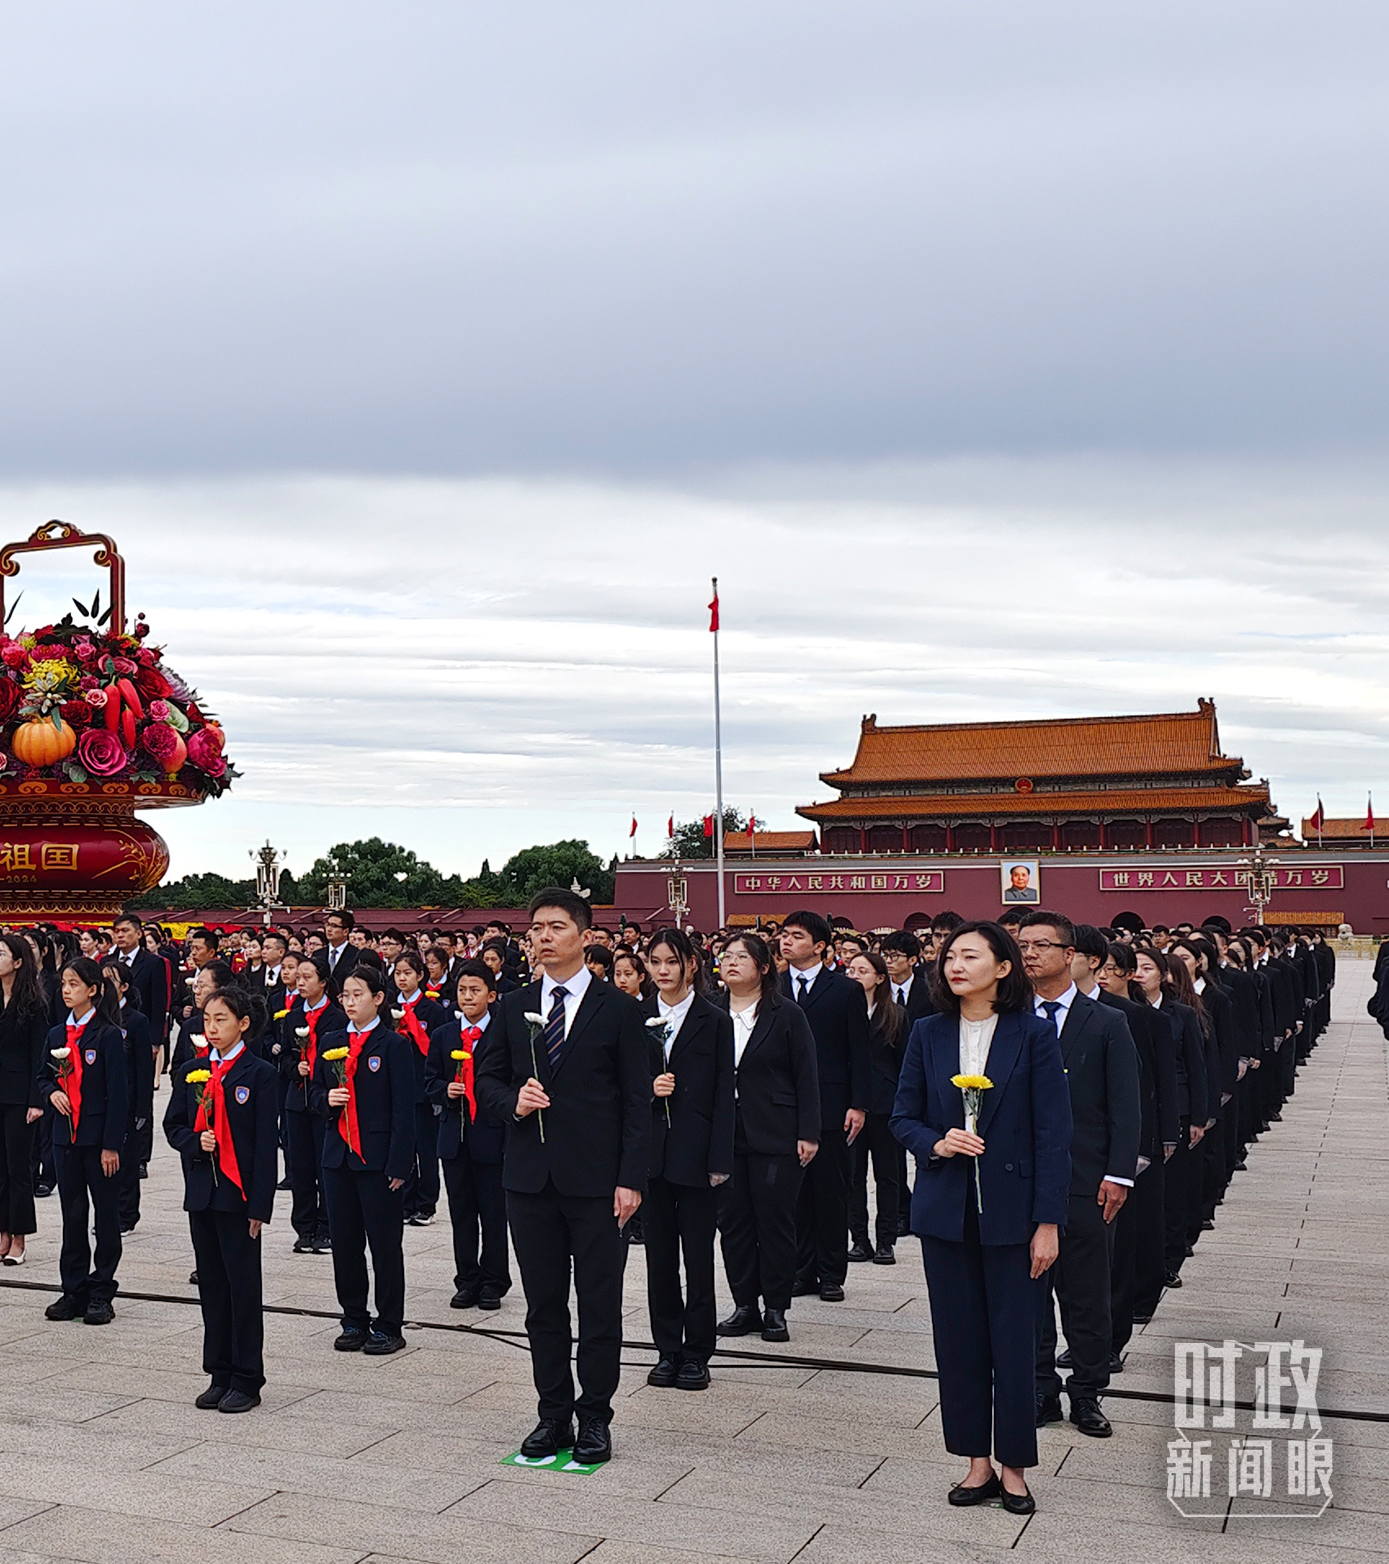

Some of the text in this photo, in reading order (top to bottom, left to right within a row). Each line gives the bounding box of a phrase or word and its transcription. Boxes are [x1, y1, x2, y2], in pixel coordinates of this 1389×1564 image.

[745, 875, 932, 890] 中华人民共和国万岁
